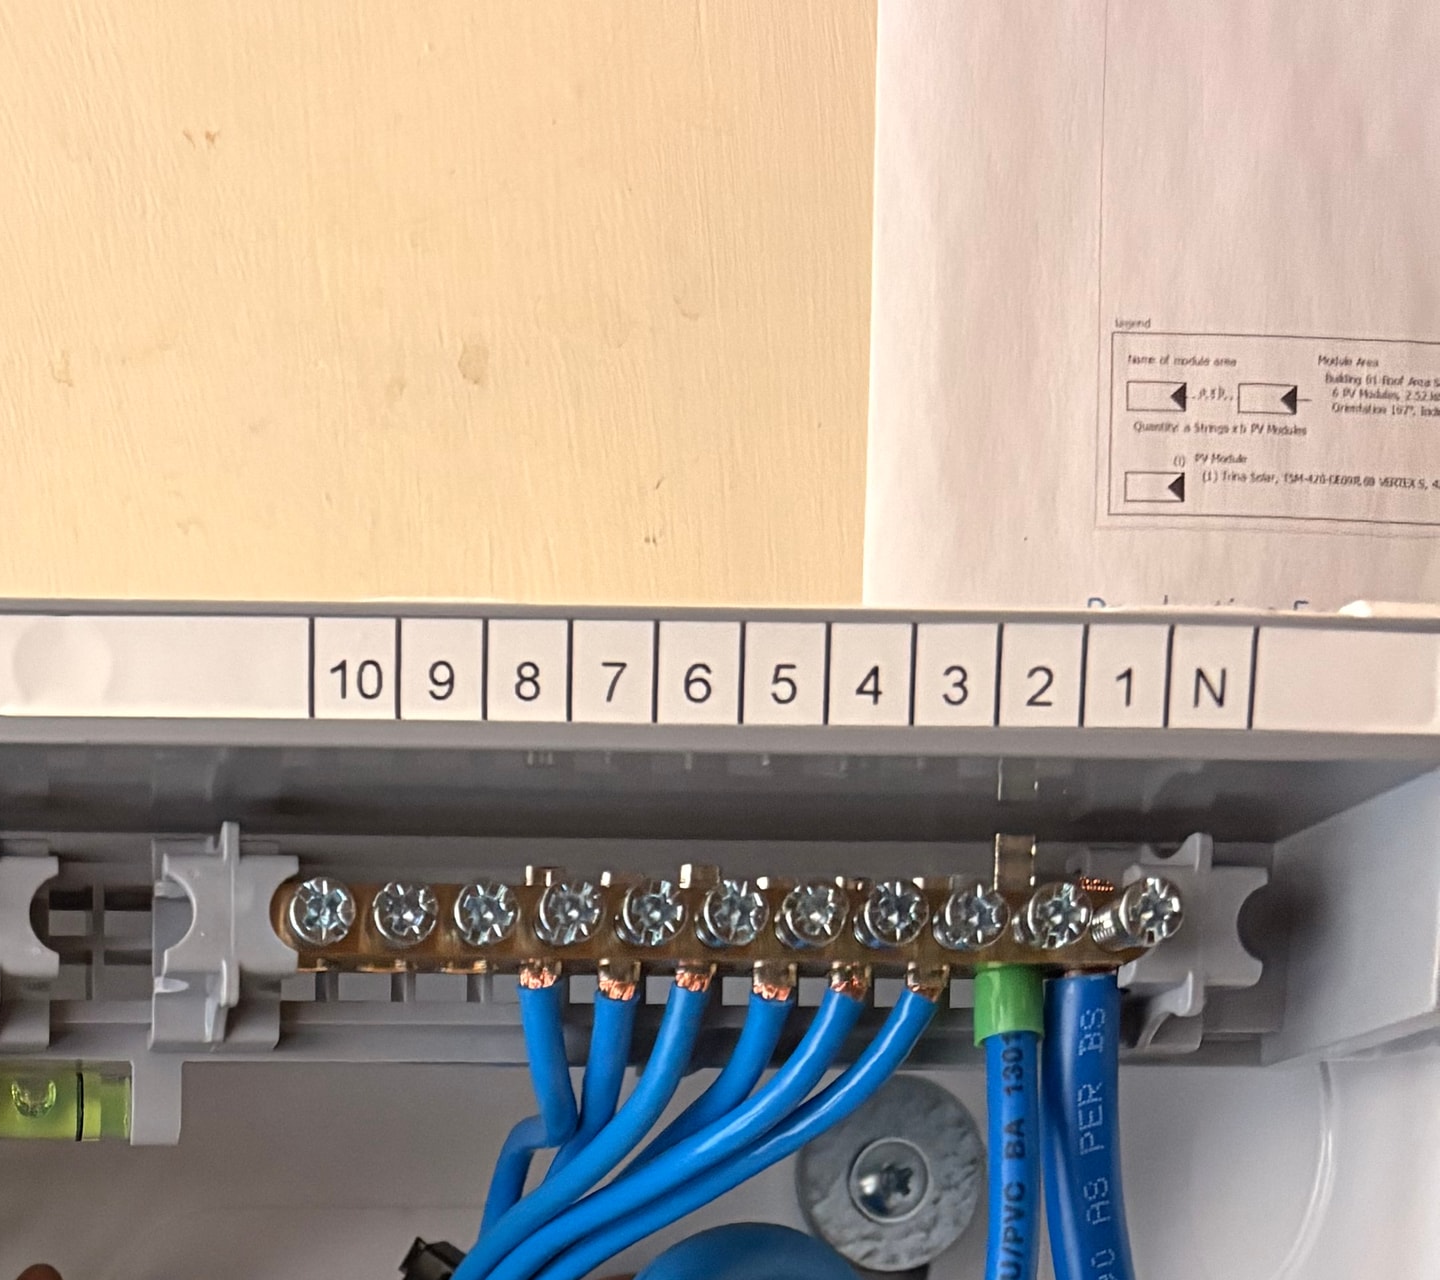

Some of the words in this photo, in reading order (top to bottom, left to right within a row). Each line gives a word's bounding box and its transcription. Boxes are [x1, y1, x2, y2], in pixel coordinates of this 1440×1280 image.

[330, 659, 383, 700] 10
[428, 660, 455, 701] 9
[514, 661, 541, 702] 8
[601, 661, 628, 703] 7
[684, 663, 712, 704] 6
[771, 663, 798, 705] 5
[855, 665, 883, 705] 4
[942, 665, 969, 706] 3
[1026, 665, 1054, 707] 2
[1116, 667, 1133, 707] 1
[1193, 667, 1227, 708] N
[1077, 1005, 1107, 1057] BS
[1003, 1116, 1026, 1161] BA
[1076, 1080, 1107, 1156] PER
[1085, 1175, 1109, 1226] AS
